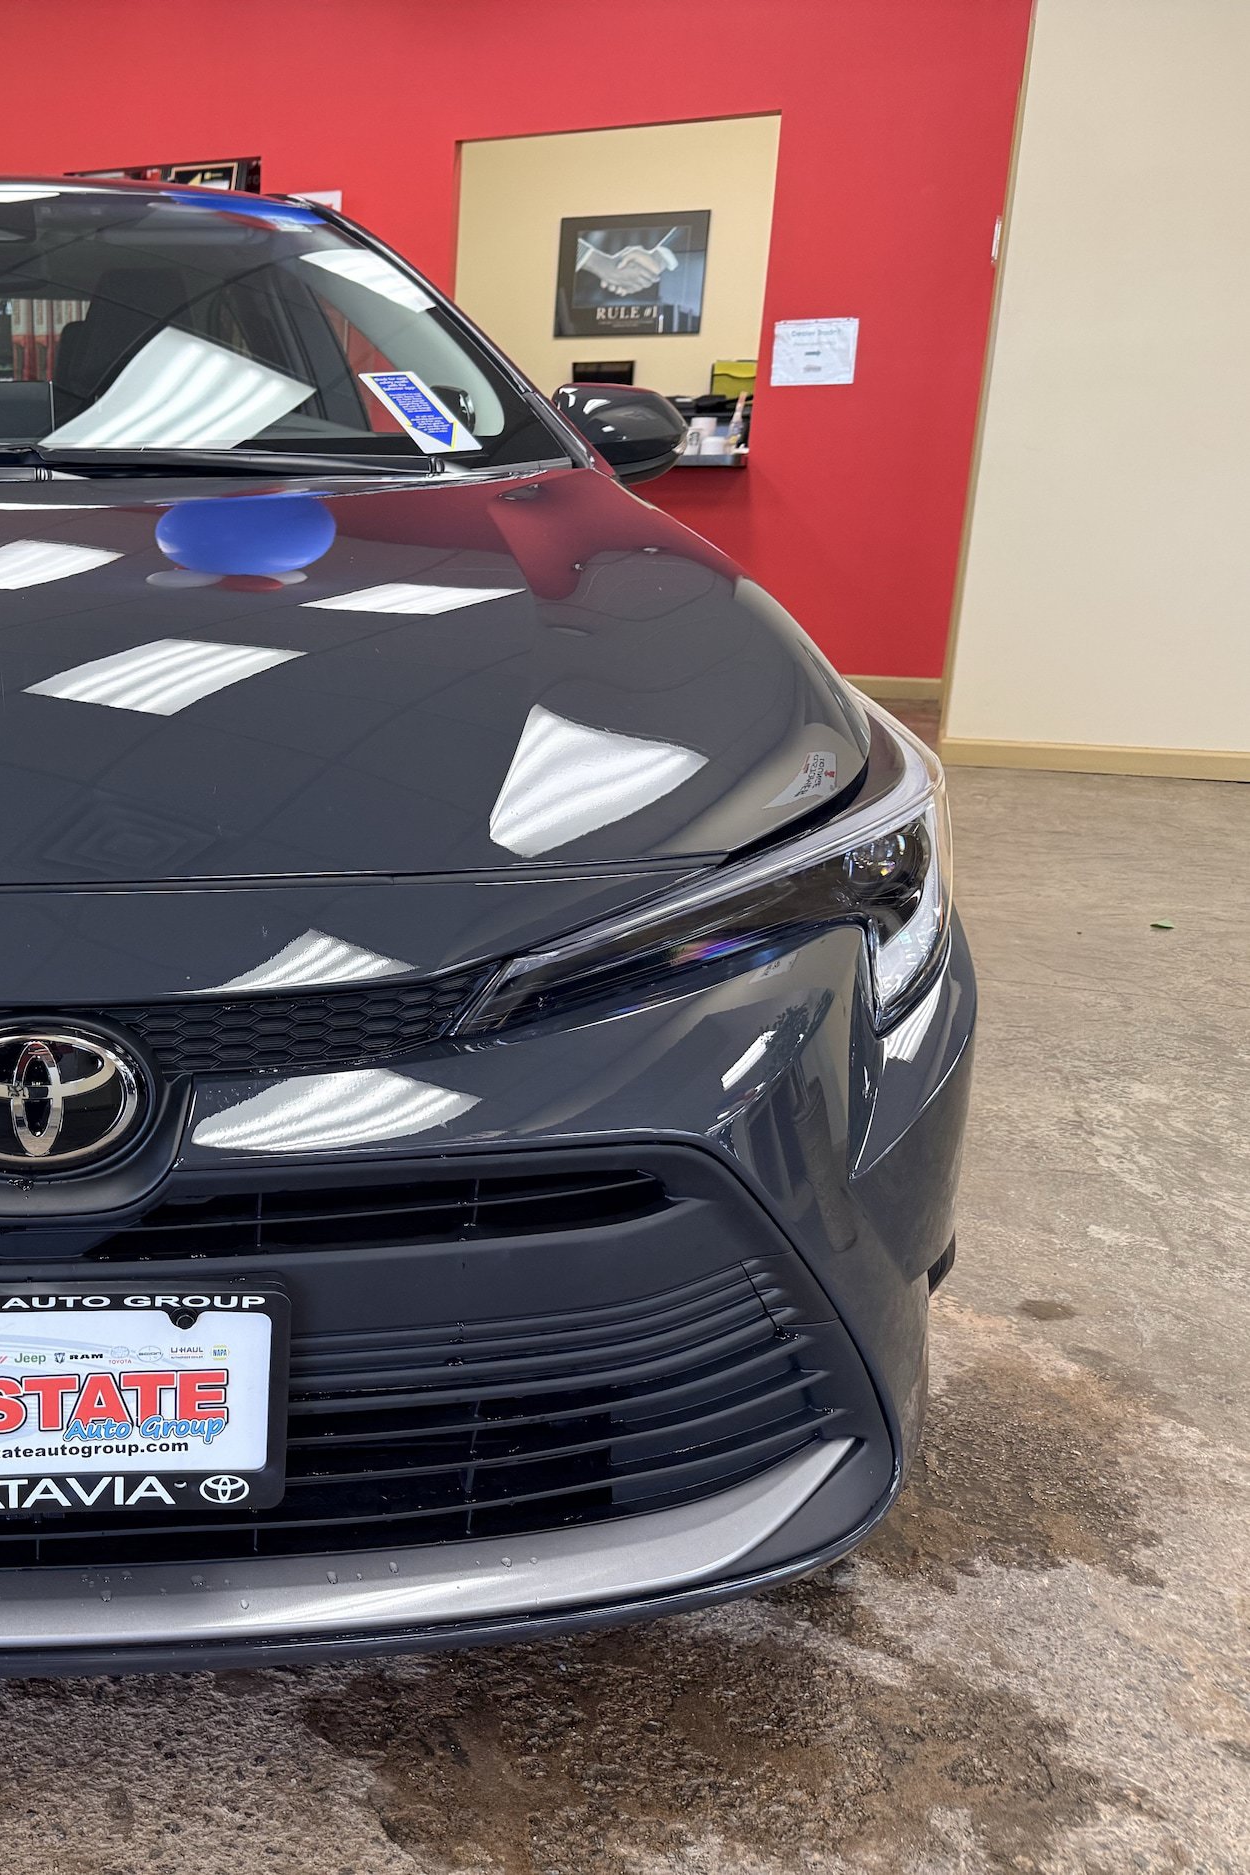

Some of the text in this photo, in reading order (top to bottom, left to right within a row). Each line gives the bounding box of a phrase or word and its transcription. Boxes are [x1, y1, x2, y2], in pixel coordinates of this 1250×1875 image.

[596, 305, 658, 320] RULE #1
[1, 1296, 111, 1310] AUTO
[123, 1295, 266, 1309] GROUP
[14, 1352, 47, 1365] Jeep
[64, 1415, 225, 1444] Auto Group
